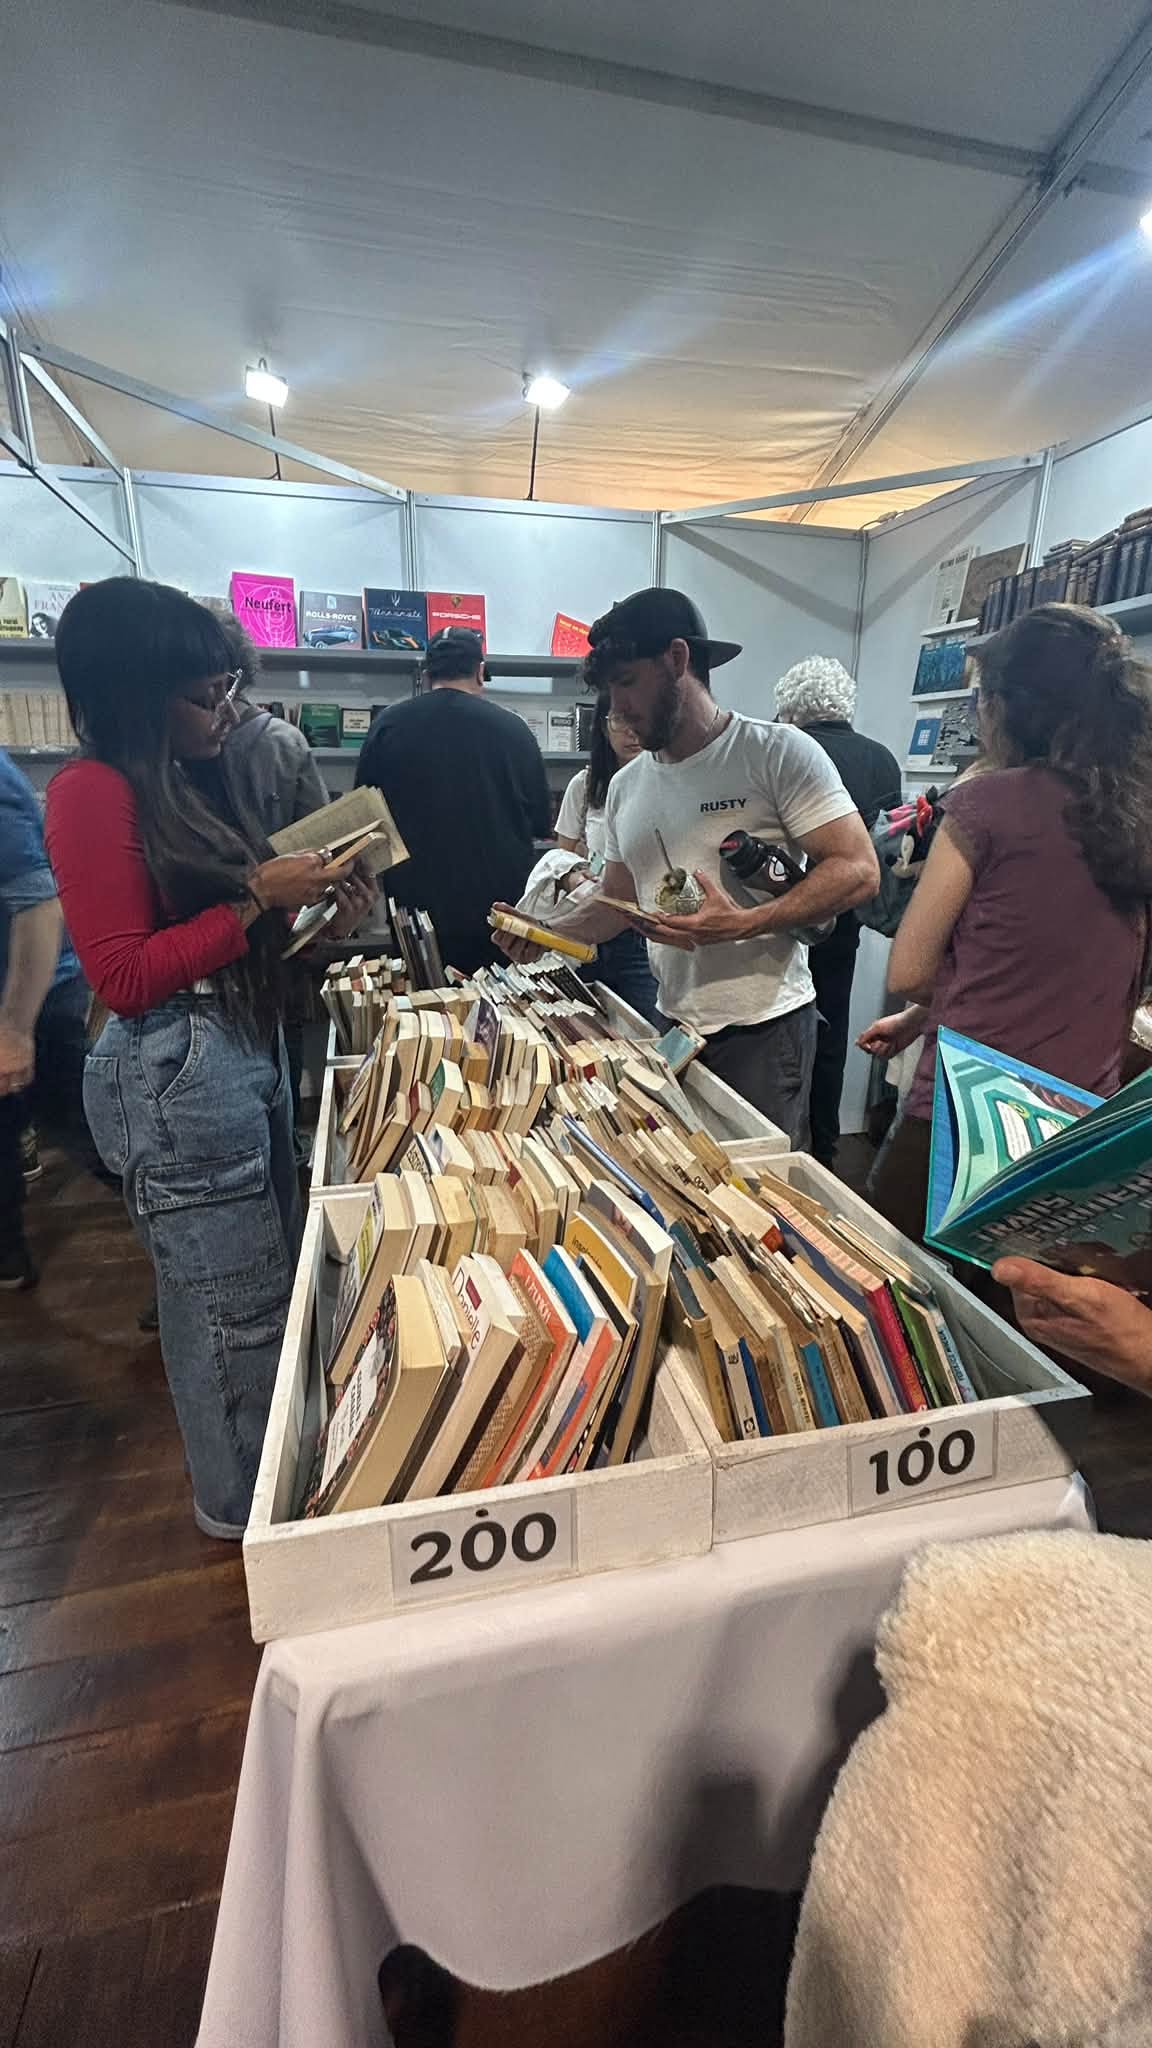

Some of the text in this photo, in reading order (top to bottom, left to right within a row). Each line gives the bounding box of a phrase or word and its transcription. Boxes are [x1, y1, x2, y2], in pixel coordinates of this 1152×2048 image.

[244, 596, 292, 614] Neufert
[305, 610, 358, 622] ROLLS-ROYCE
[431, 610, 481, 621] PORSCHE
[700, 797, 747, 813] RUSTY
[869, 1429, 976, 1495] 100
[410, 1511, 557, 1585] 200
